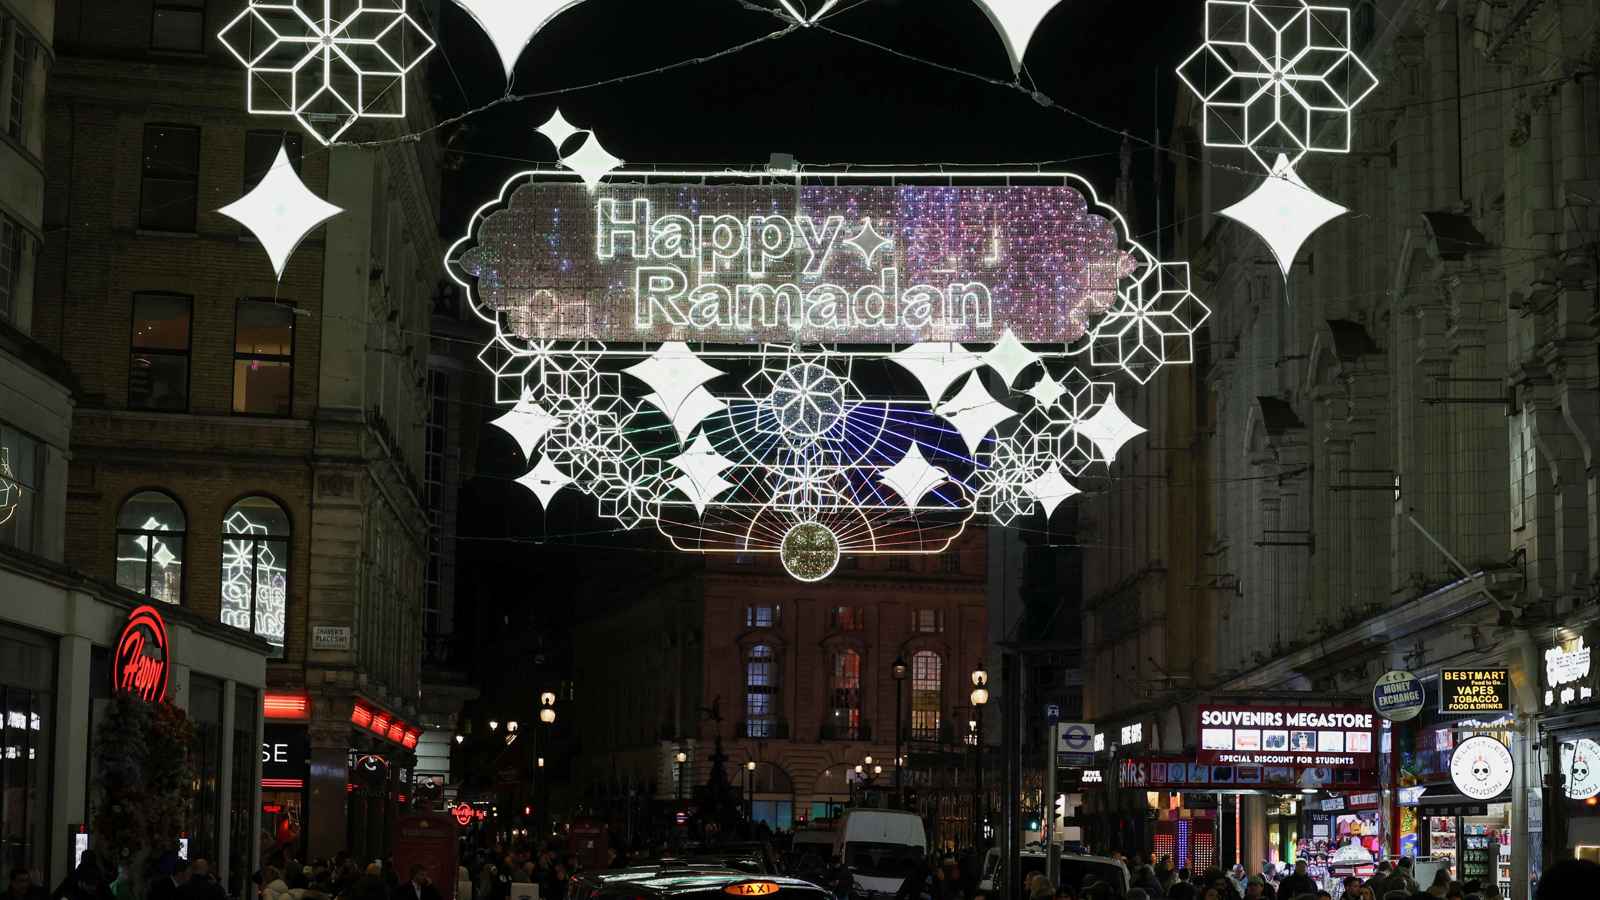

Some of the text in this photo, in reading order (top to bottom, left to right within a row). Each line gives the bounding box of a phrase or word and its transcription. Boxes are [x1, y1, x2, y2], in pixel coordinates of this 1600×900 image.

[595, 197, 845, 276] Happy
[635, 266, 993, 330] Ramadan
[122, 631, 164, 703] Happy
[1444, 671, 1506, 680] BESTMART
[1383, 682, 1411, 695] MONEY
[1457, 686, 1494, 695] VAPES
[1378, 690, 1420, 706] EXCHANGE
[1452, 695, 1499, 703] TOBACCO
[1202, 711, 1284, 727] SOUVENIRS
[1286, 713, 1373, 728] MEGASTORE
[261, 743, 289, 763] SE
[1219, 754, 1355, 765] SPECIAL DISCOUNT FOR STUDENTS
[736, 884, 770, 894] TAXI
